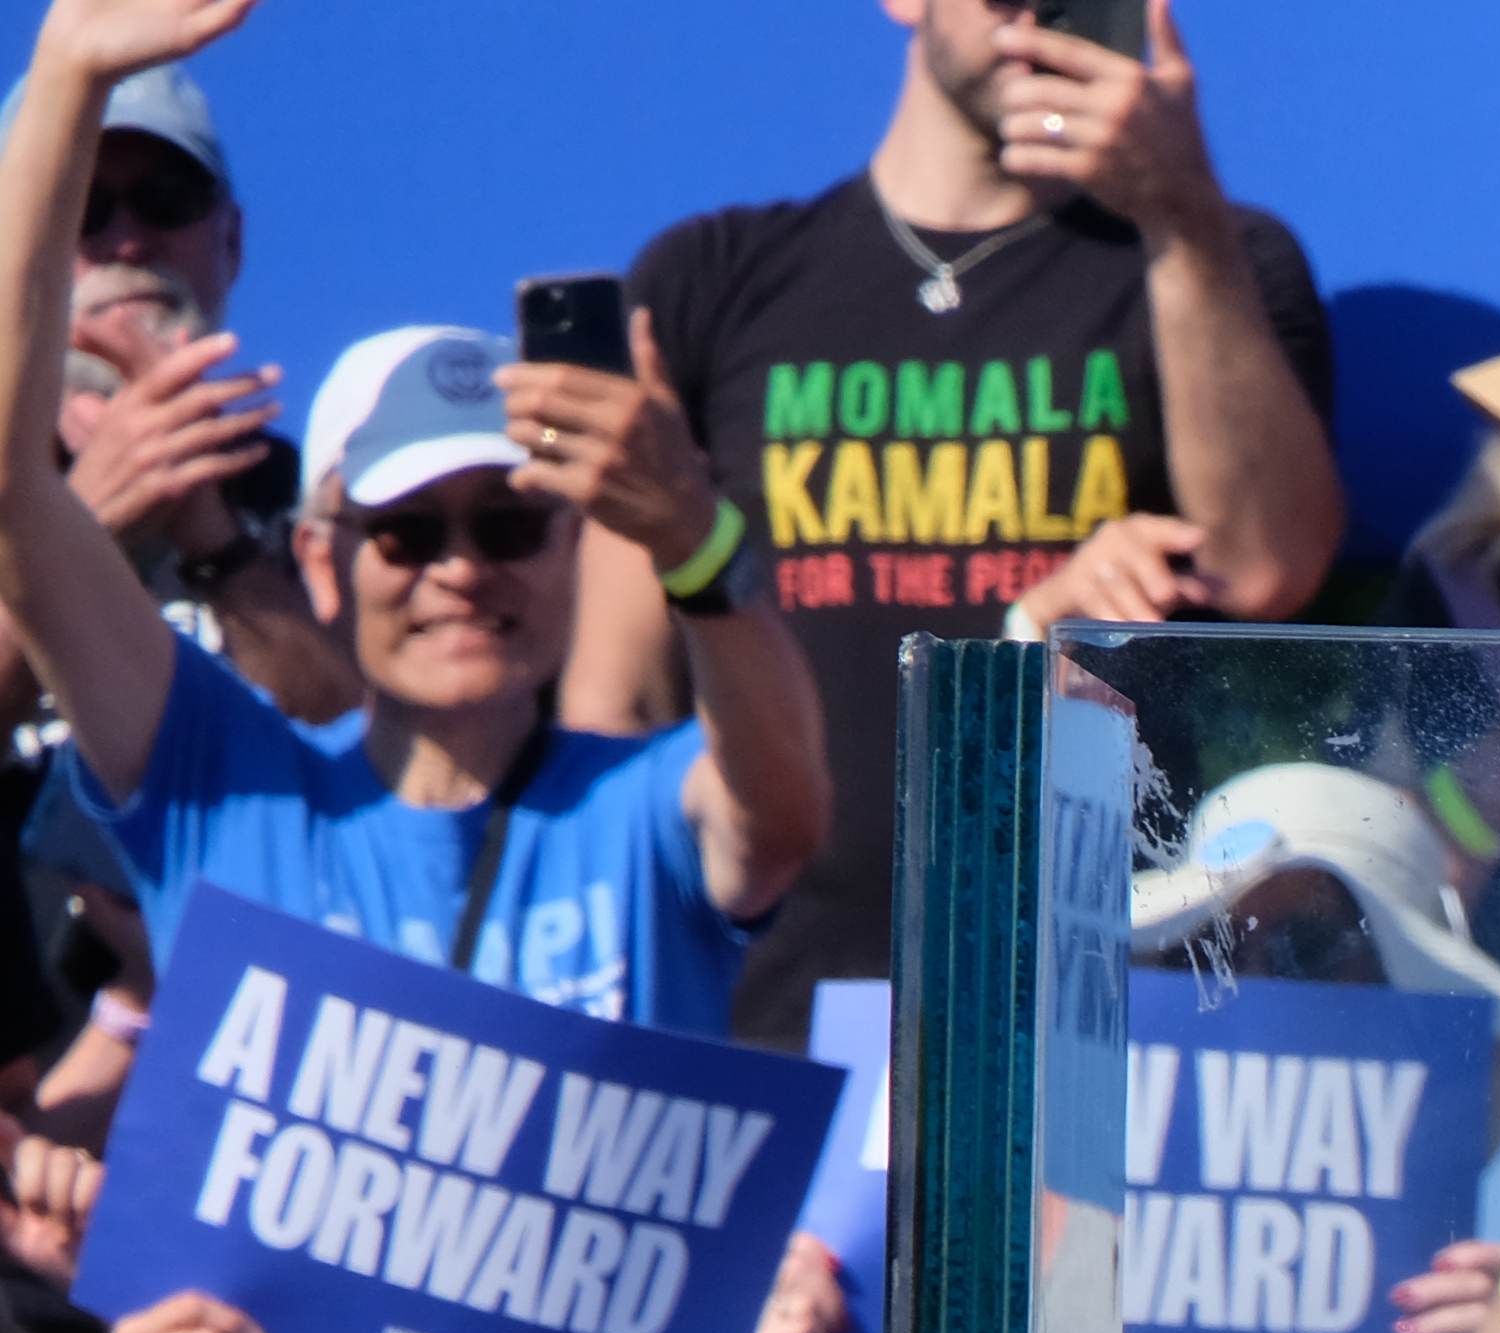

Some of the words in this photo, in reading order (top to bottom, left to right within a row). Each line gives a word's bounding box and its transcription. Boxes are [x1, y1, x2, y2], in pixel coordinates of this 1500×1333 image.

[764, 349, 1129, 438] MOMALA
[762, 435, 1129, 547] KAMALA
[776, 553, 854, 610] FOR
[868, 553, 955, 607] THE
[966, 549, 1070, 602] PEO
[199, 966, 286, 1100] A
[289, 995, 545, 1178] NEW
[544, 1072, 775, 1229] WAY
[1200, 1046, 1428, 1198] WAY
